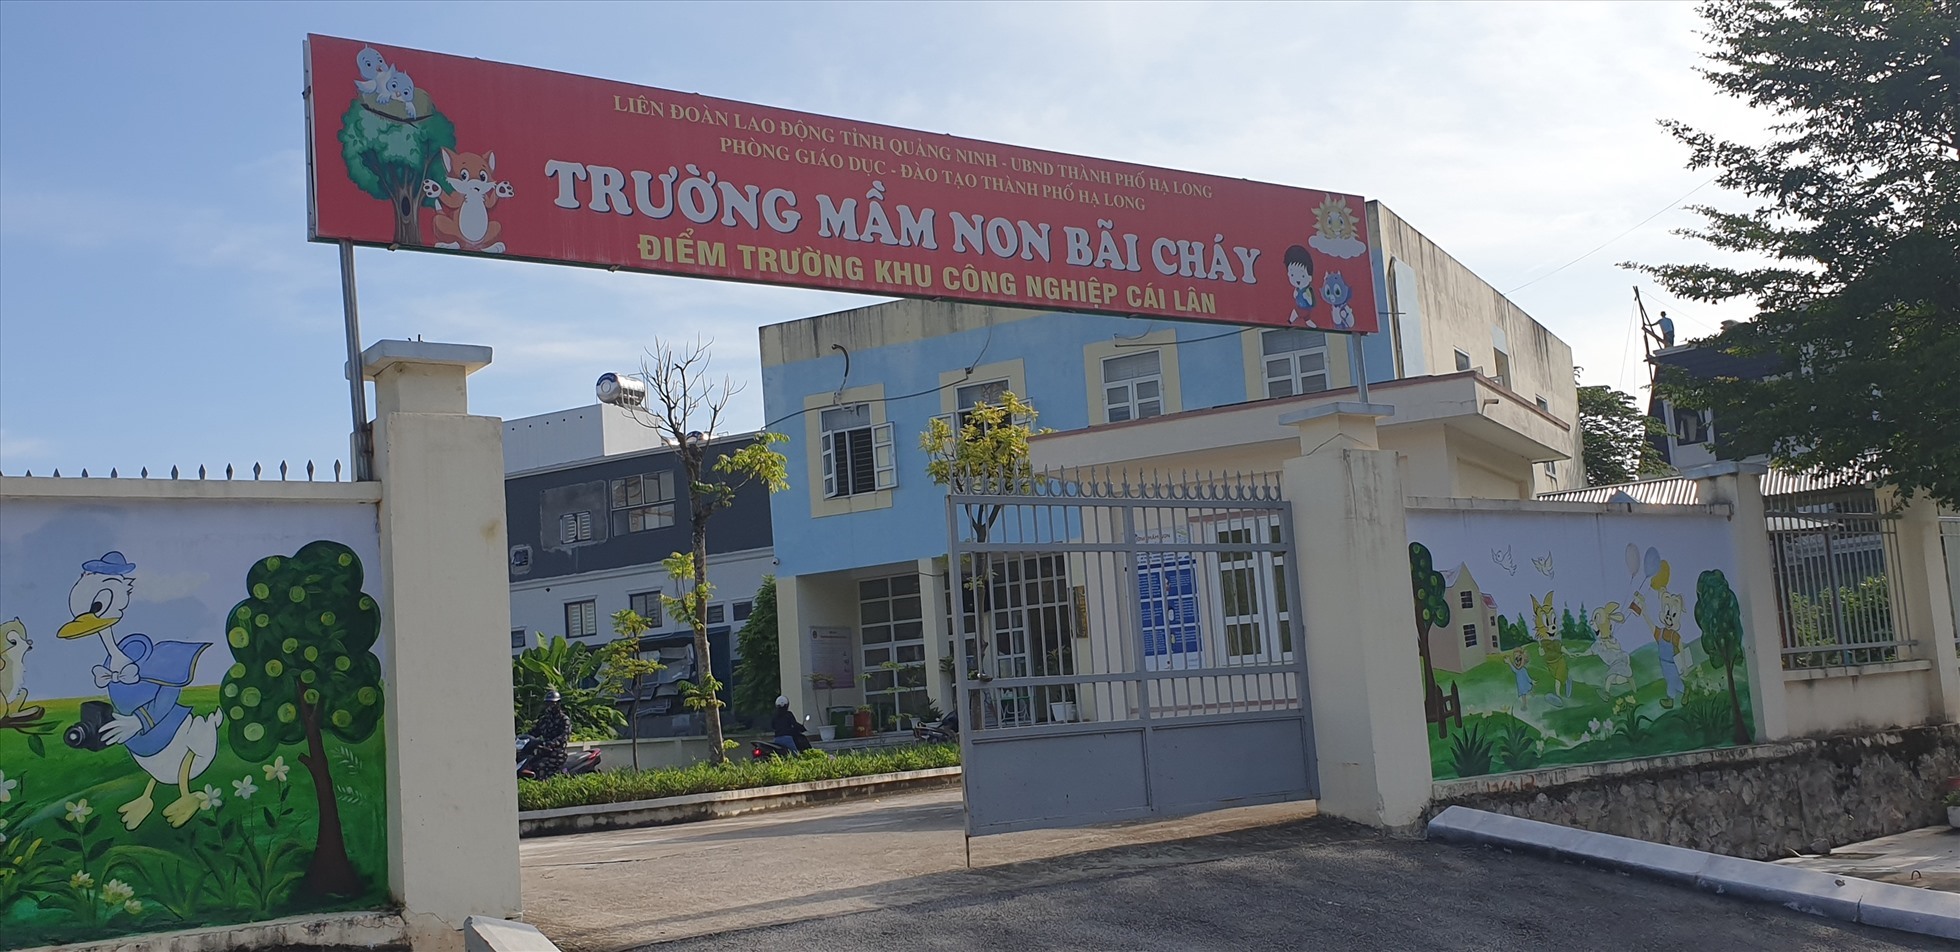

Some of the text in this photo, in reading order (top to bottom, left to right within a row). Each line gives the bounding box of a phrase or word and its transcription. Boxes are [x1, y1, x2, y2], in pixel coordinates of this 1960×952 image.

[613, 95, 665, 117] LIÊN
[670, 103, 728, 127] ĐOÀN
[734, 113, 776, 134] LAO
[780, 120, 835, 143] ĐỘNG
[840, 128, 884, 151] TỈNH
[890, 138, 951, 161] QUẢNG
[956, 149, 997, 168] NINH
[1011, 158, 1054, 177] UBND
[1058, 164, 1112, 185] THÀNH
[1115, 170, 1146, 190] PHỐ
[1149, 178, 1170, 195] HẠ
[1174, 181, 1213, 199] LONG
[720, 137, 790, 161] PHÒNG
[795, 148, 844, 169] GIÁO
[849, 157, 886, 177] DỤC
[900, 161, 938, 183] ĐÀO
[942, 170, 977, 188] TẠO
[981, 175, 1038, 197] THÀNH
[1042, 182, 1075, 202] PHỐ
[1079, 191, 1100, 207] HẠ
[1104, 195, 1146, 211] LONG
[544, 159, 1261, 284] TRƯỜNG MẦM NON BÃI CHÁY
[637, 228, 1216, 315] ĐIỂM TRƯỜNG KHU CÔNG NGHIỆP CÁI LÂN
